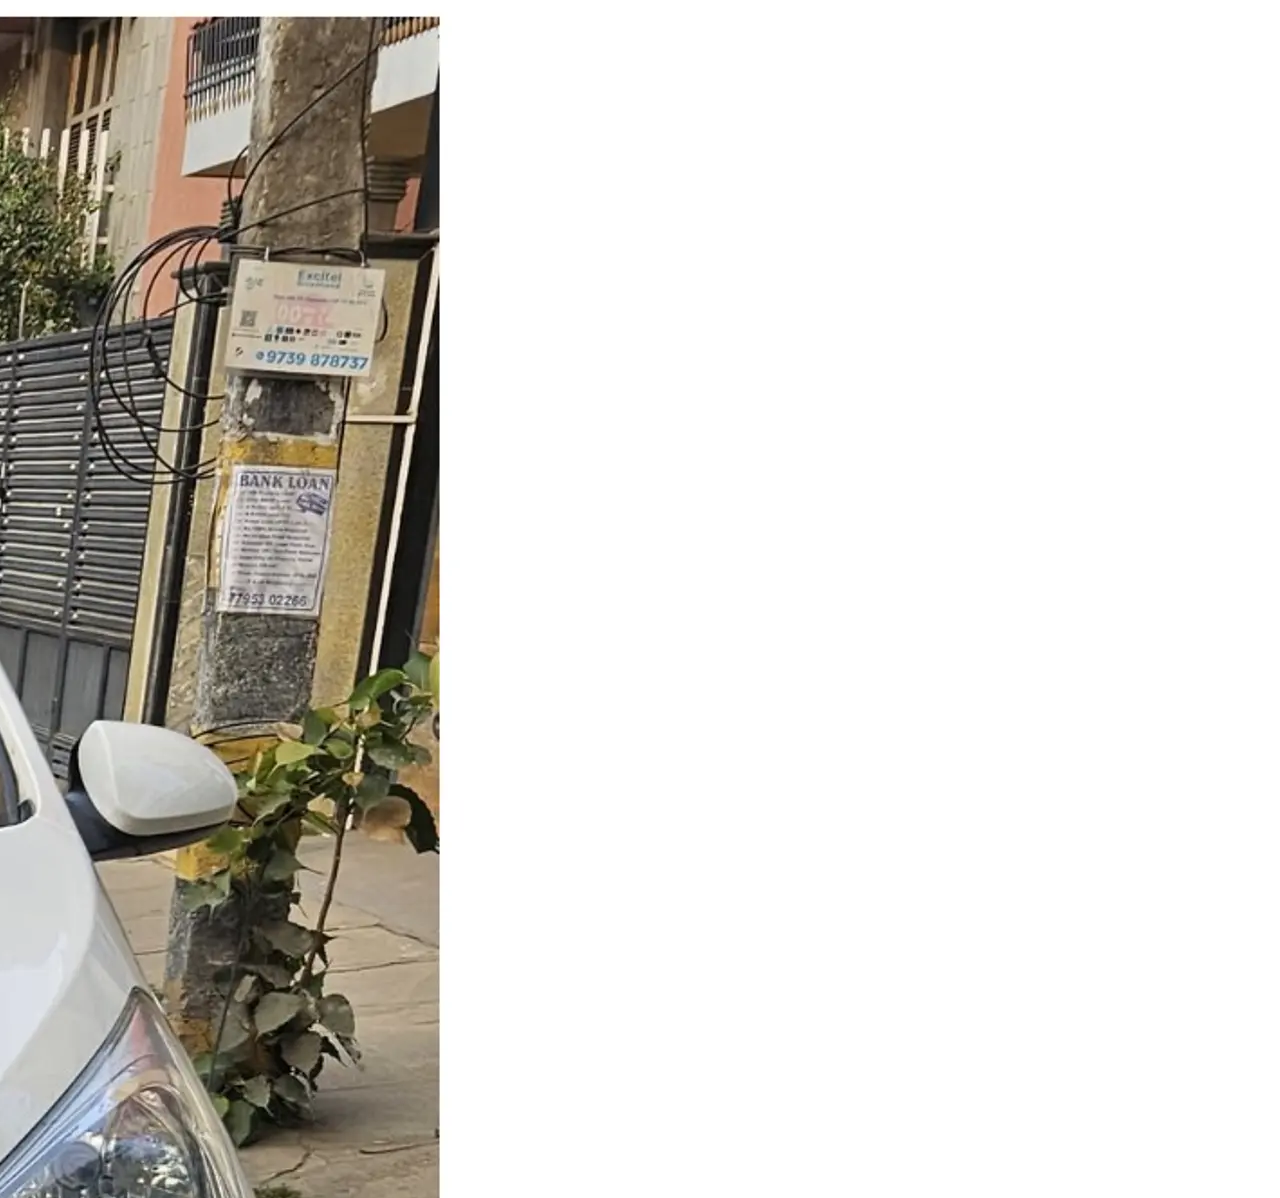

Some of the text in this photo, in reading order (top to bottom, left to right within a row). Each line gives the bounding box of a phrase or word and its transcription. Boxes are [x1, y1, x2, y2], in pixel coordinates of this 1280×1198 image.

[266, 350, 369, 369] 9739 878737
[240, 474, 330, 490] BANK LOAN
